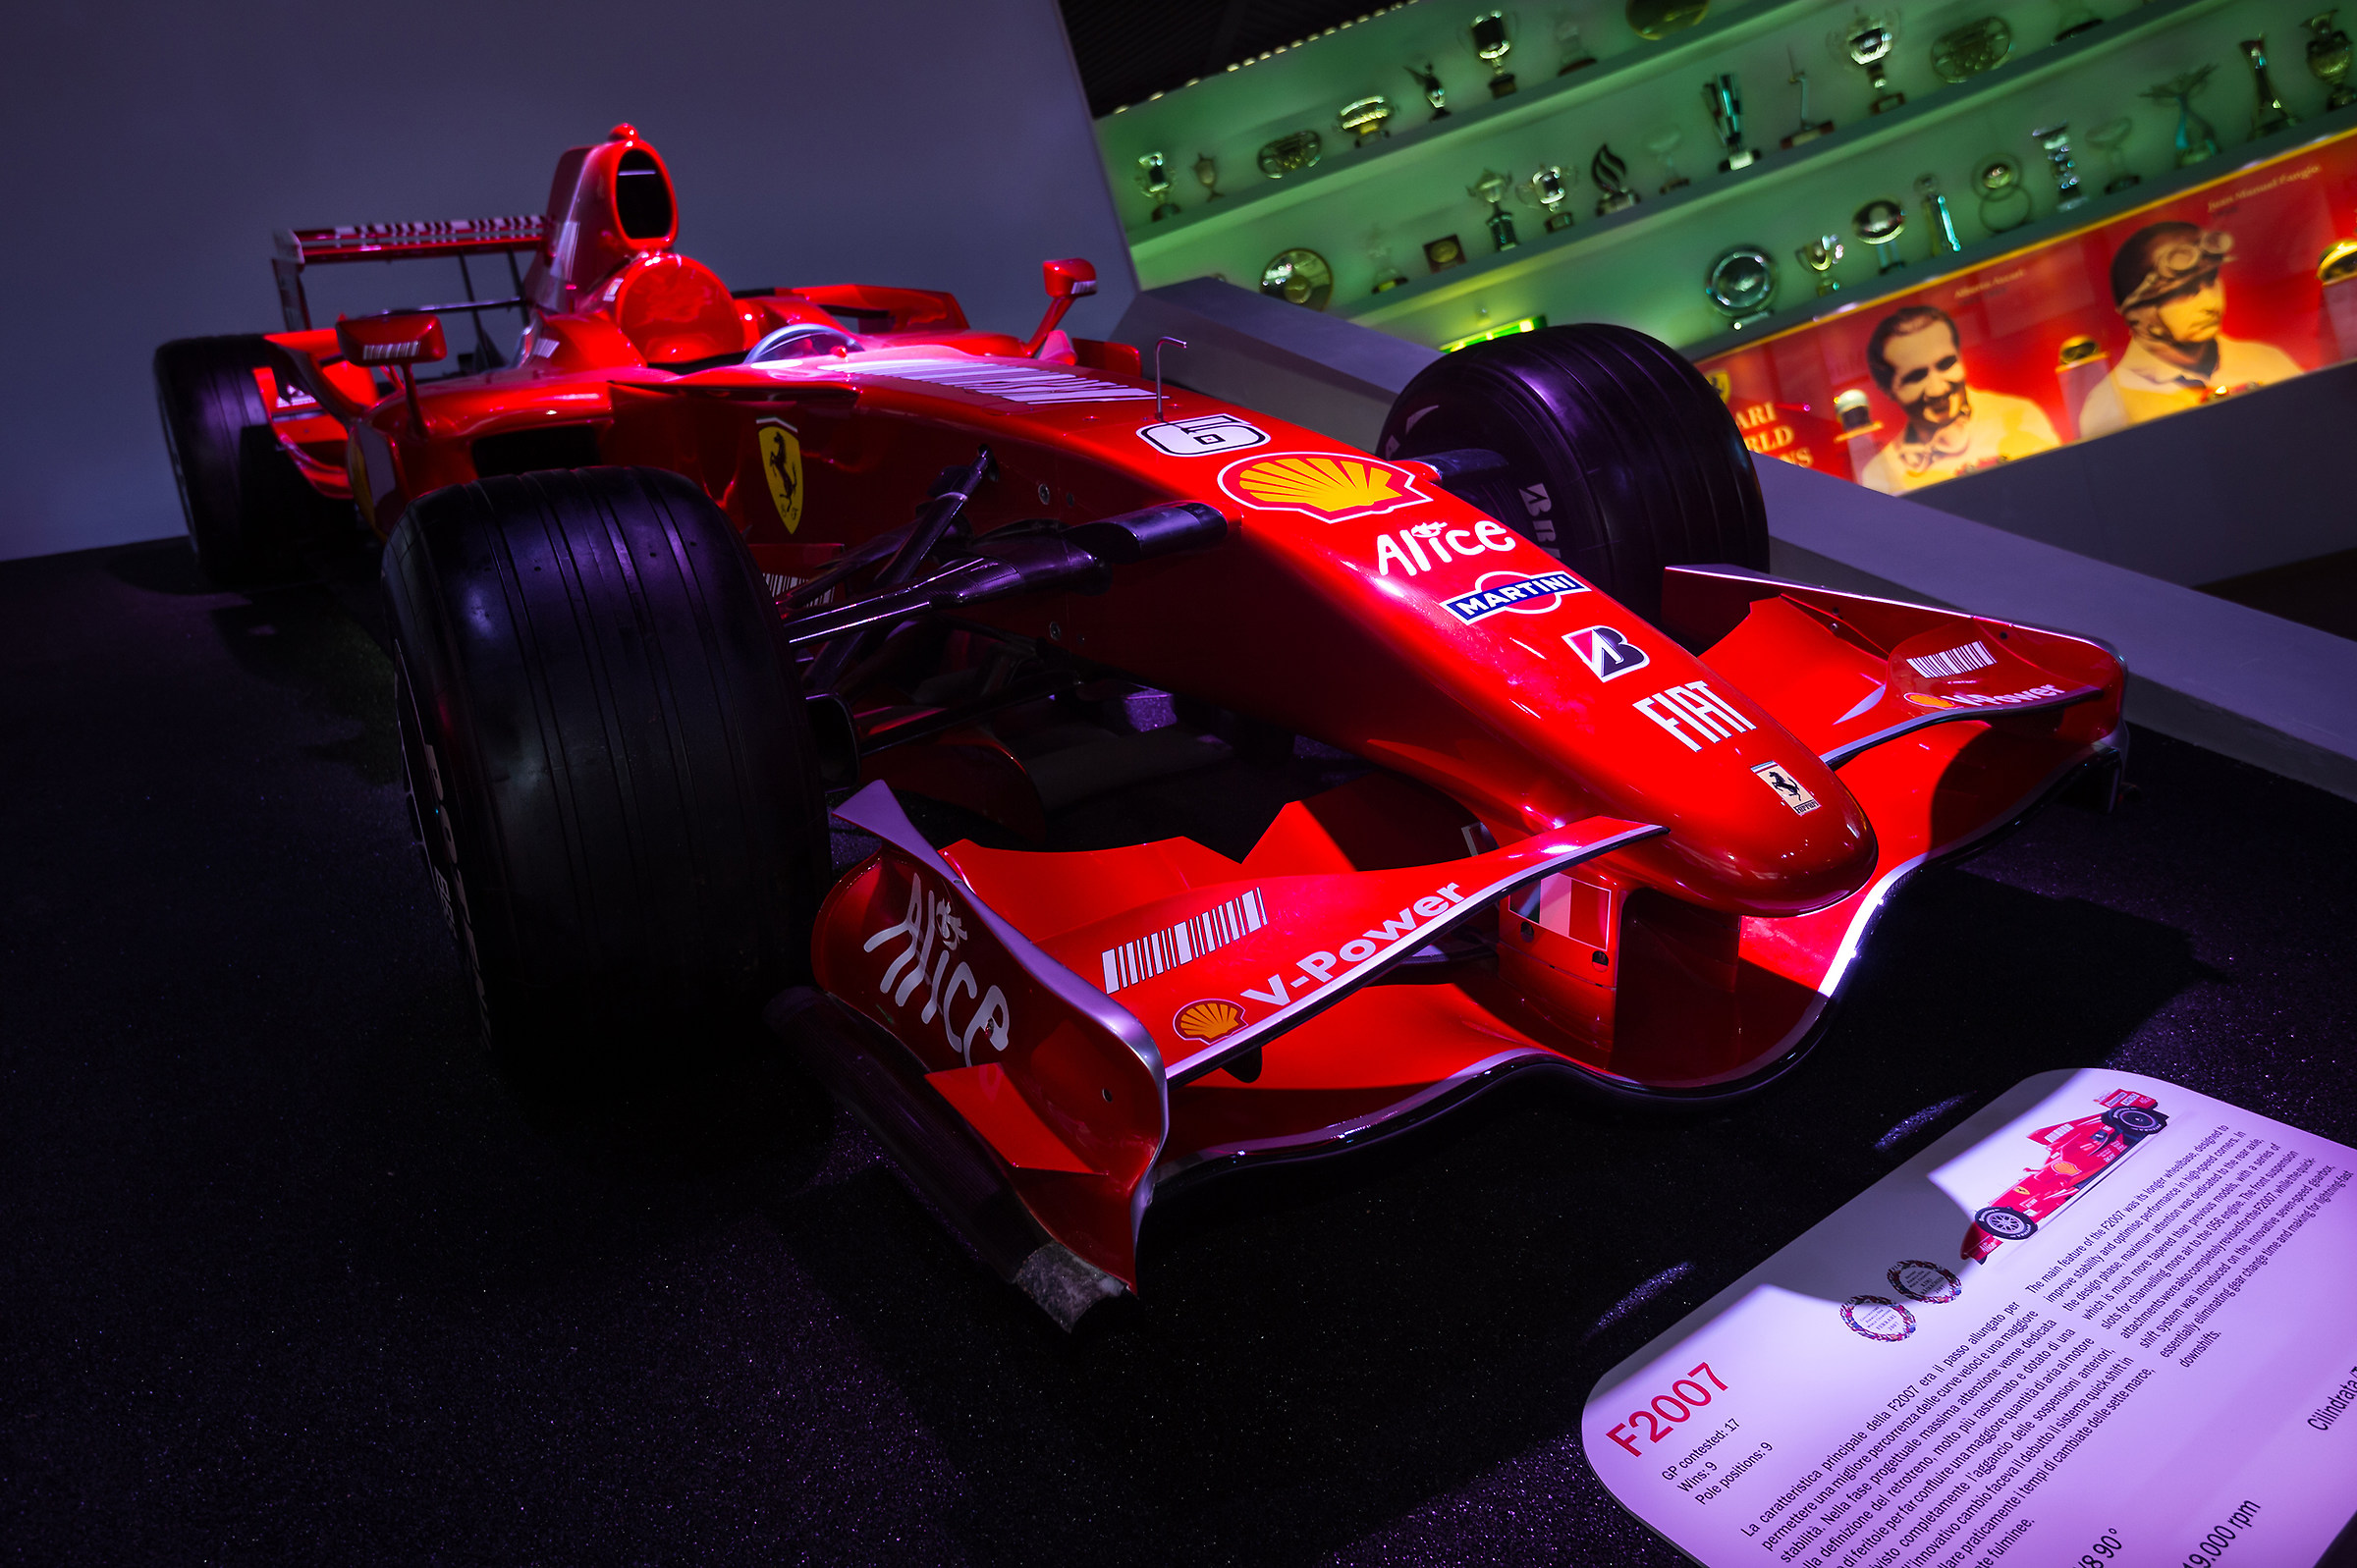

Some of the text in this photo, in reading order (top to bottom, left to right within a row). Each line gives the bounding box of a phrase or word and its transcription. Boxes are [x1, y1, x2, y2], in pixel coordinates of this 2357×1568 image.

[1139, 414, 1269, 456] 6
[1735, 401, 1778, 429] ARI
[1743, 425, 1795, 455] RLD
[1377, 520, 1516, 576] Alice
[1455, 575, 1576, 616] MARTINI
[1632, 680, 1757, 752] FIAT
[863, 872, 1010, 1067] Alice
[1239, 883, 1464, 1006] V-Power
[2024, 1280, 2045, 1293] The
[2041, 1266, 2062, 1283] main
[2056, 1245, 2087, 1268] feature
[2083, 1236, 2095, 1247] of
[2089, 1228, 2106, 1240] the
[2100, 1210, 2125, 1230] F2007
[2122, 1200, 2140, 1213] was
[2133, 1193, 2149, 1202] its
[2142, 1176, 2166, 1195] longer
[2163, 1152, 2199, 1178] wheelbase,
[2193, 1129, 2222, 1152] designed
[2043, 1276, 2076, 1303] improve
[2073, 1254, 2105, 1278] stability
[2099, 1241, 2116, 1256] and
[2112, 1219, 2143, 1244] optimise
[2140, 1187, 2181, 1222] performance
[2181, 1154, 2218, 1183] high-speed
[2214, 1137, 2240, 1157] corners.
[2061, 1299, 2080, 1312] the
[2075, 1278, 2103, 1300] design
[2098, 1261, 2125, 1282] phase,
[2120, 1232, 2156, 1262] maximum
[2151, 1209, 2182, 1234] attention
[2177, 1197, 2195, 1210] was
[2190, 1171, 2222, 1199] dedicated
[2222, 1159, 2239, 1169] the
[2234, 1148, 2250, 1161] rear
[2246, 1138, 2265, 1151] axle,
[2139, 1164, 2335, 1348] shift system was introduced on the innovative seven-speed gearbox,
[2179, 1330, 2221, 1368] downshifts.
[1606, 1362, 1728, 1457] F2007
[1740, 1301, 2020, 1537] La caratteristica principale della F2007 era il passo allungato per
[1761, 1502, 1818, 1551] permettere
[1813, 1486, 1836, 1504] una
[1831, 1455, 1872, 1488] migliore
[1867, 1412, 1921, 1459] percorrenza
[1915, 1395, 1941, 1415] delle
[1936, 1377, 1962, 1397] curve
[1956, 1355, 1985, 1378] veloci
[1985, 1339, 2005, 1354] una
[2000, 1310, 2038, 1342] maggiore
[1780, 1320, 2056, 1563] stabilità. Nella fase progettuale massima attenzione venne dedicata
[2307, 1366, 2357, 1431] Cilindrata
[1661, 1418, 1739, 1481] GP contested: 17
[1676, 1461, 1718, 1492] Wins: 9
[1694, 1441, 1773, 1505] Pole positions: 9
[1801, 1556, 1824, 1568] lla
[1820, 1510, 1873, 1557] definizione
[1870, 1493, 1891, 1511] del
[1887, 1456, 1938, 1497] retrotreno,
[1932, 1432, 1961, 1456] molto
[1957, 1417, 1977, 1434] più
[1972, 1379, 2019, 1419] rastremato
[2022, 1350, 2052, 1374] dotato
[2047, 1340, 2060, 1351] di
[2056, 1328, 2076, 1343] una
[1867, 1347, 2115, 1568] visto completamente l'aggancio delle sospensioni anteriori,
[1900, 1357, 2134, 1568] l'innovativo cambio faceva il debutto il sistema quick shift in
[1936, 1368, 2156, 1568] lare praticamente i tempi di cambiate delle sette marce,
[1974, 1519, 2035, 1568] te fulminee.
[2227, 1500, 2262, 1529] rpm
